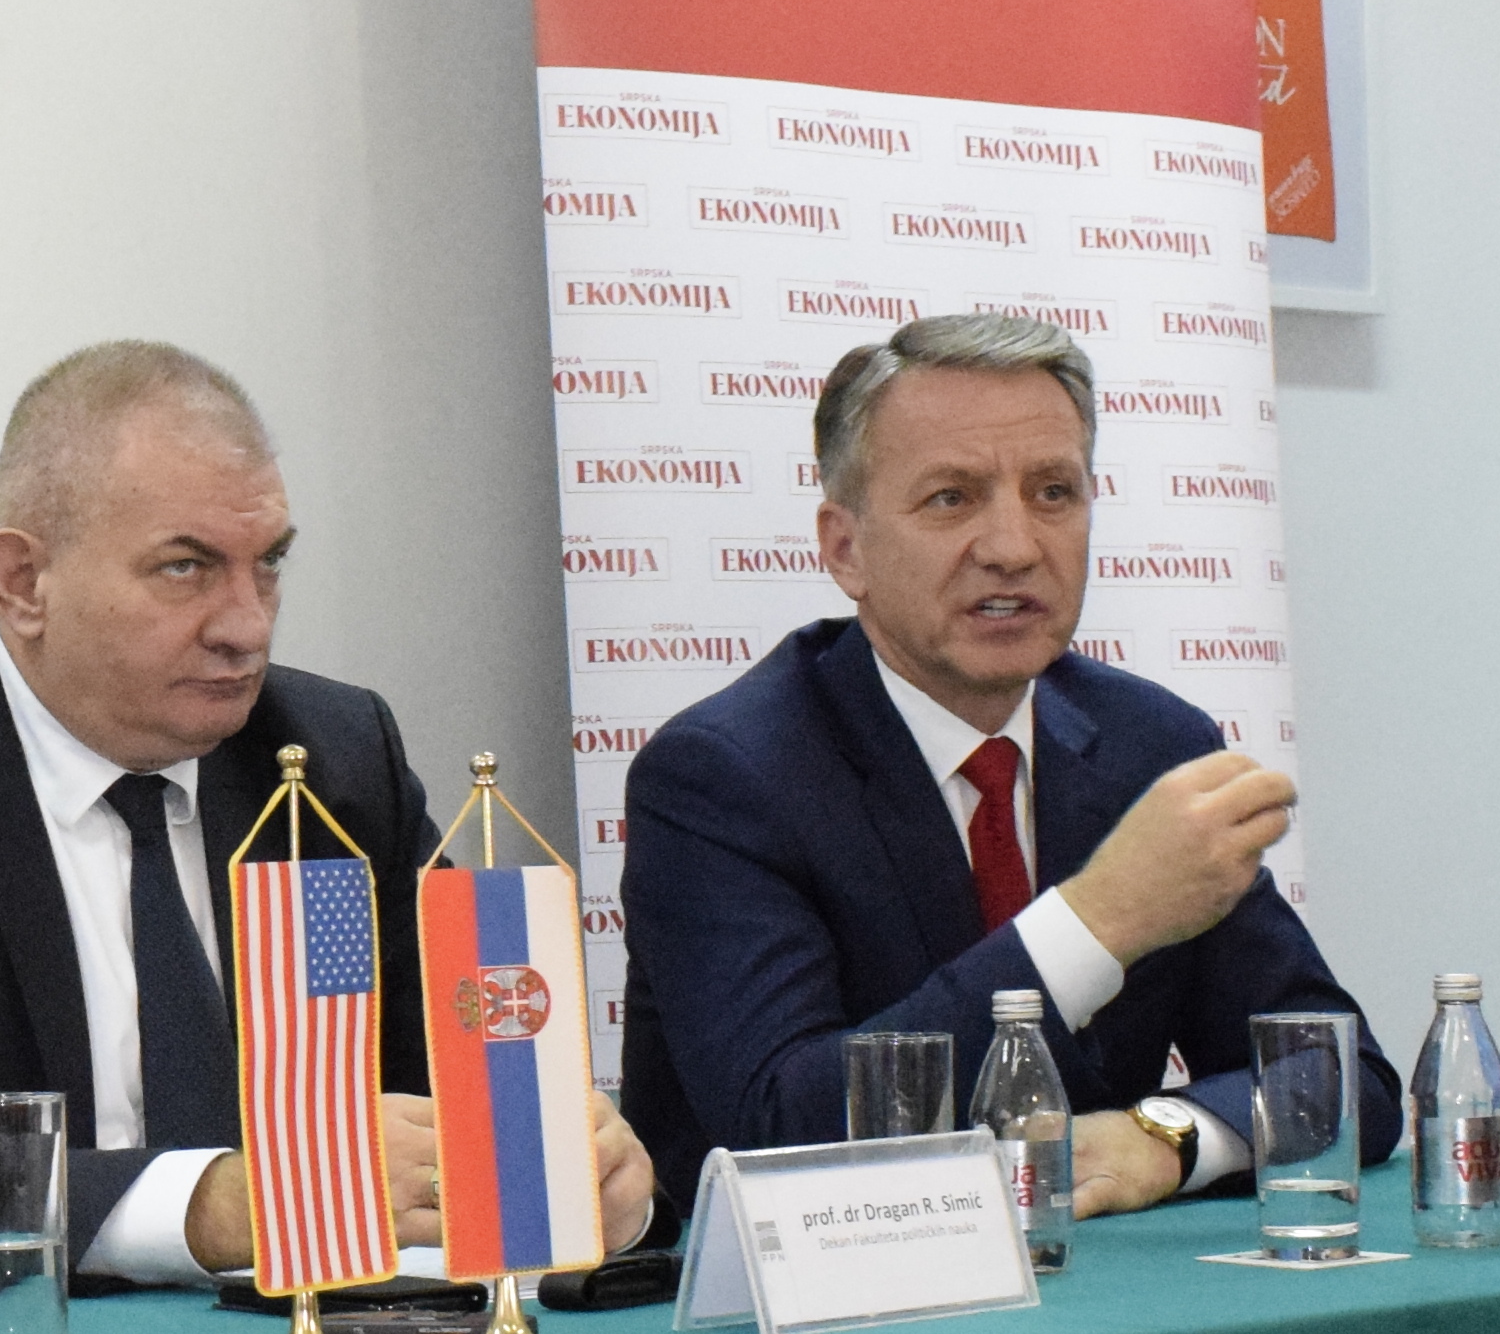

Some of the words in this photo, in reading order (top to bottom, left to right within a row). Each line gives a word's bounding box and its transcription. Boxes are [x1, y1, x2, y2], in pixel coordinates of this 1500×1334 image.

[619, 92, 661, 103] SRPSKA
[556, 104, 720, 139] EKONOMIJA
[777, 117, 911, 156] EKONOMIJA
[965, 135, 1099, 170] EKONOMIJA
[1154, 149, 1258, 187] EKONOMIJA
[543, 191, 637, 222] OMIJA
[699, 197, 841, 234] EKONOMIJA
[892, 212, 1027, 248] EKONOMIJA
[1080, 226, 1212, 259] EKONOMIJA
[630, 268, 673, 278] SRPSKA
[566, 281, 732, 314] EKONOMIJA
[787, 289, 920, 325] EKONOMIJA
[1162, 311, 1267, 346] EKONOMIJA
[552, 370, 648, 400] OMIJA
[640, 445, 684, 455] SRPSKA
[576, 459, 743, 489] EKONOMIJA
[1171, 474, 1277, 506] EKONOMIJA
[561, 548, 659, 578] OMIJA
[1097, 555, 1233, 584] EKONOMIJA
[651, 623, 695, 633] SRPSKA
[586, 637, 753, 667] EKONOMIJA
[802, 1206, 840, 1232] prof.
[844, 1204, 860, 1223] dr
[864, 1201, 920, 1222] Dragan
[922, 1197, 939, 1215] R.
[942, 1191, 983, 1213] Simić
